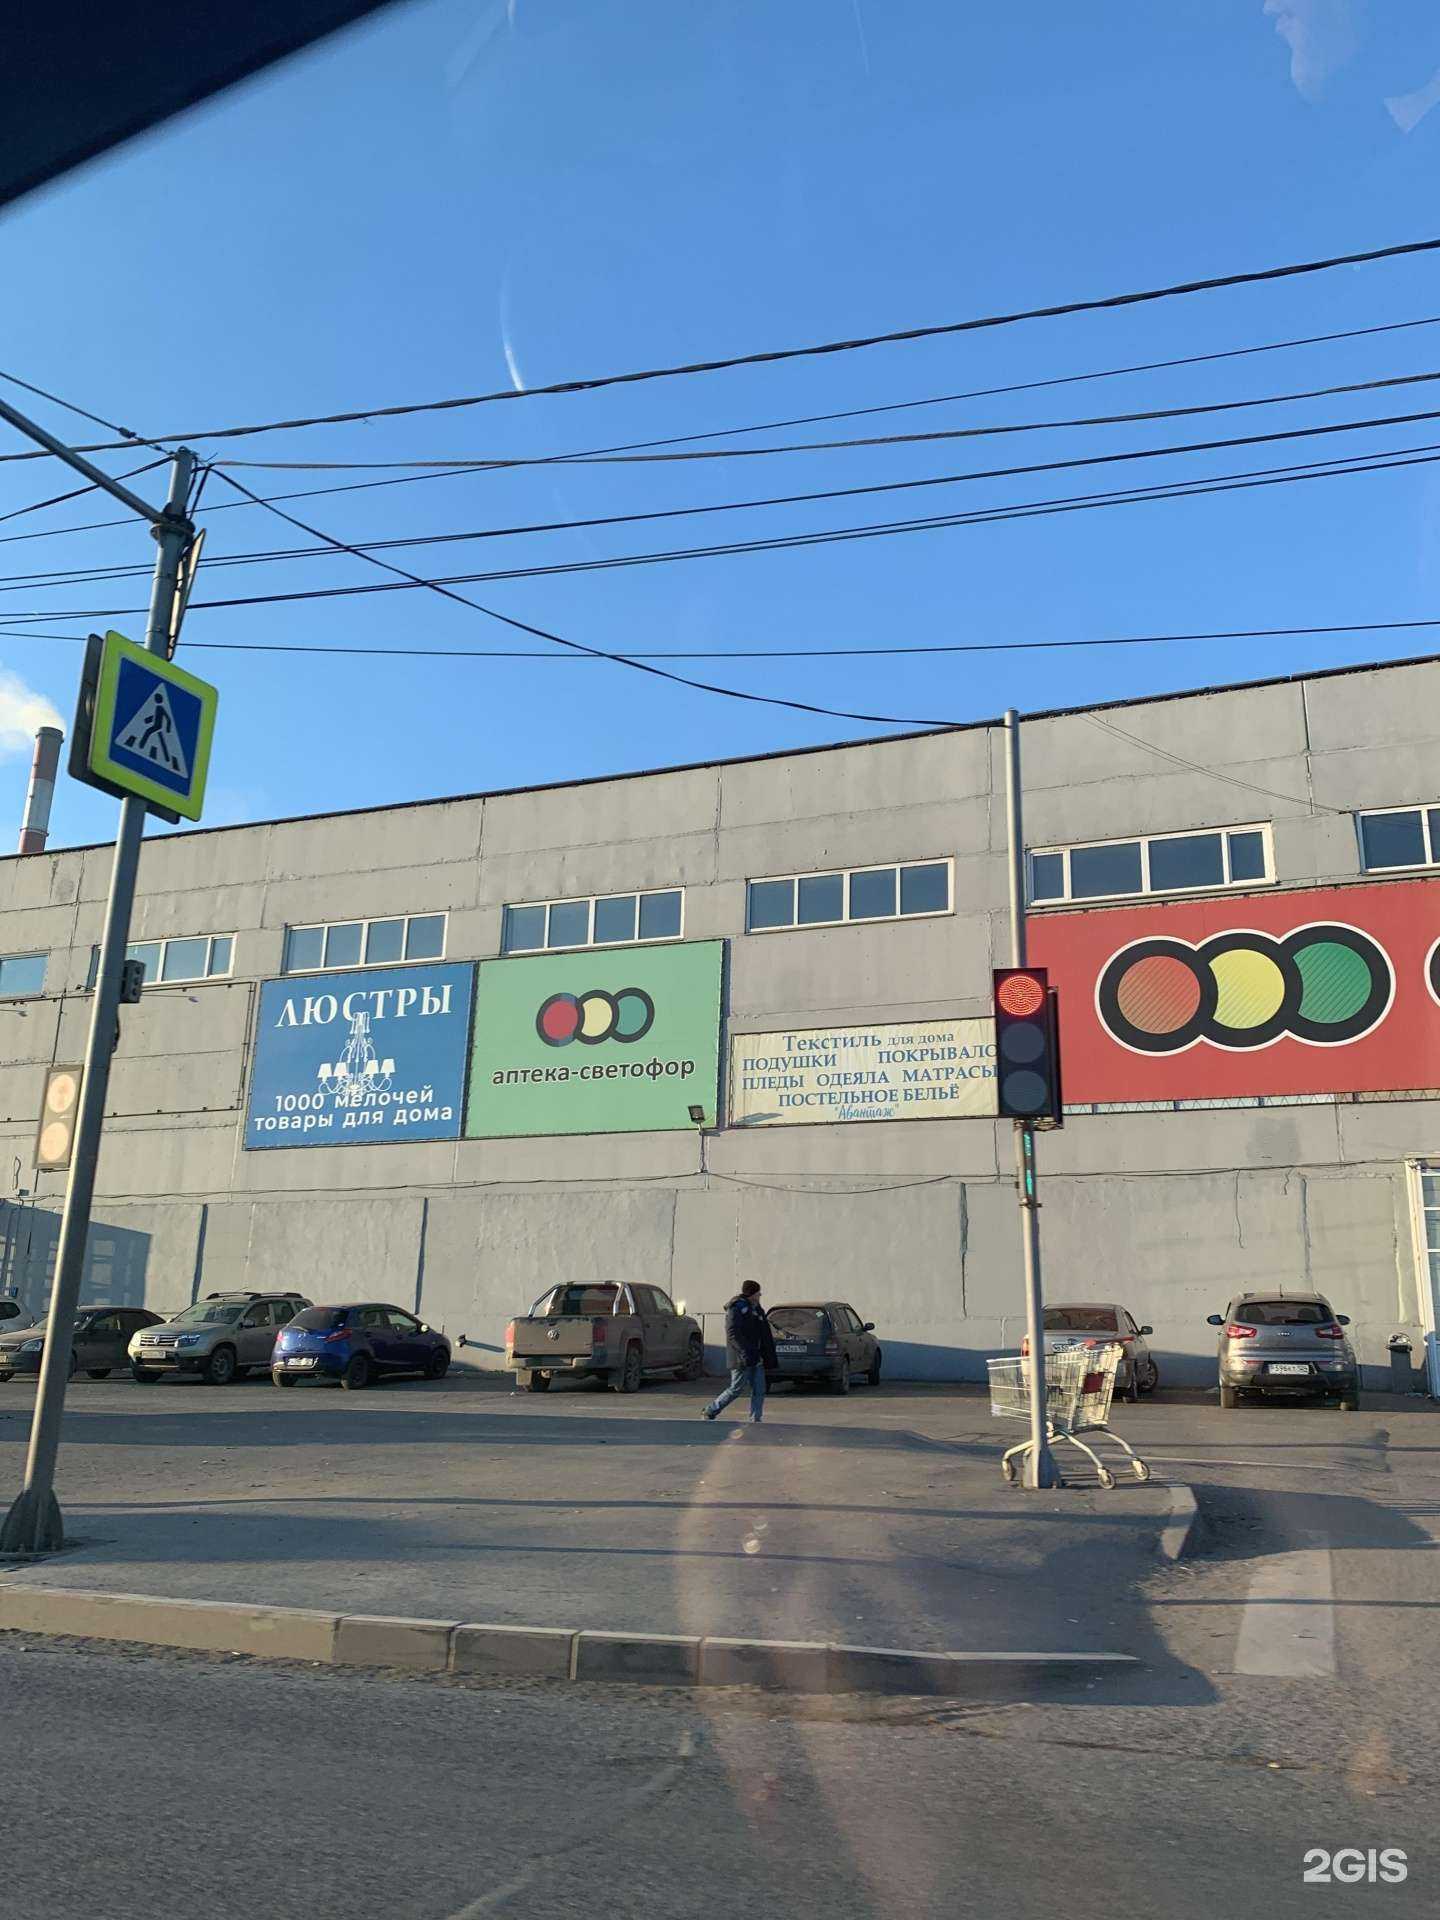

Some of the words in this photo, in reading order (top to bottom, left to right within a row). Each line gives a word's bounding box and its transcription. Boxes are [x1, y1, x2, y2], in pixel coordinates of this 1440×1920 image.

[274, 984, 453, 1028] ЛЮСТРЫ
[887, 1035, 914, 1046] для
[918, 1032, 955, 1044] дома
[492, 1057, 695, 1085] аптека-светофор
[742, 1054, 837, 1072] ПОДУШКИ
[742, 1074, 804, 1090] ПЛЕДЫ
[816, 1070, 890, 1087] ОДЕЯЛА
[902, 1065, 999, 1083] МАТРАСЫ
[275, 1093, 324, 1112] 1000
[334, 1085, 433, 1108] мелочей
[778, 1089, 899, 1107] ПОСТЕЛЬНОЕ
[903, 1083, 960, 1102] БЕЛЬЁ
[254, 1112, 332, 1132] товары
[342, 1110, 384, 1128] для
[393, 1106, 453, 1125] дома
